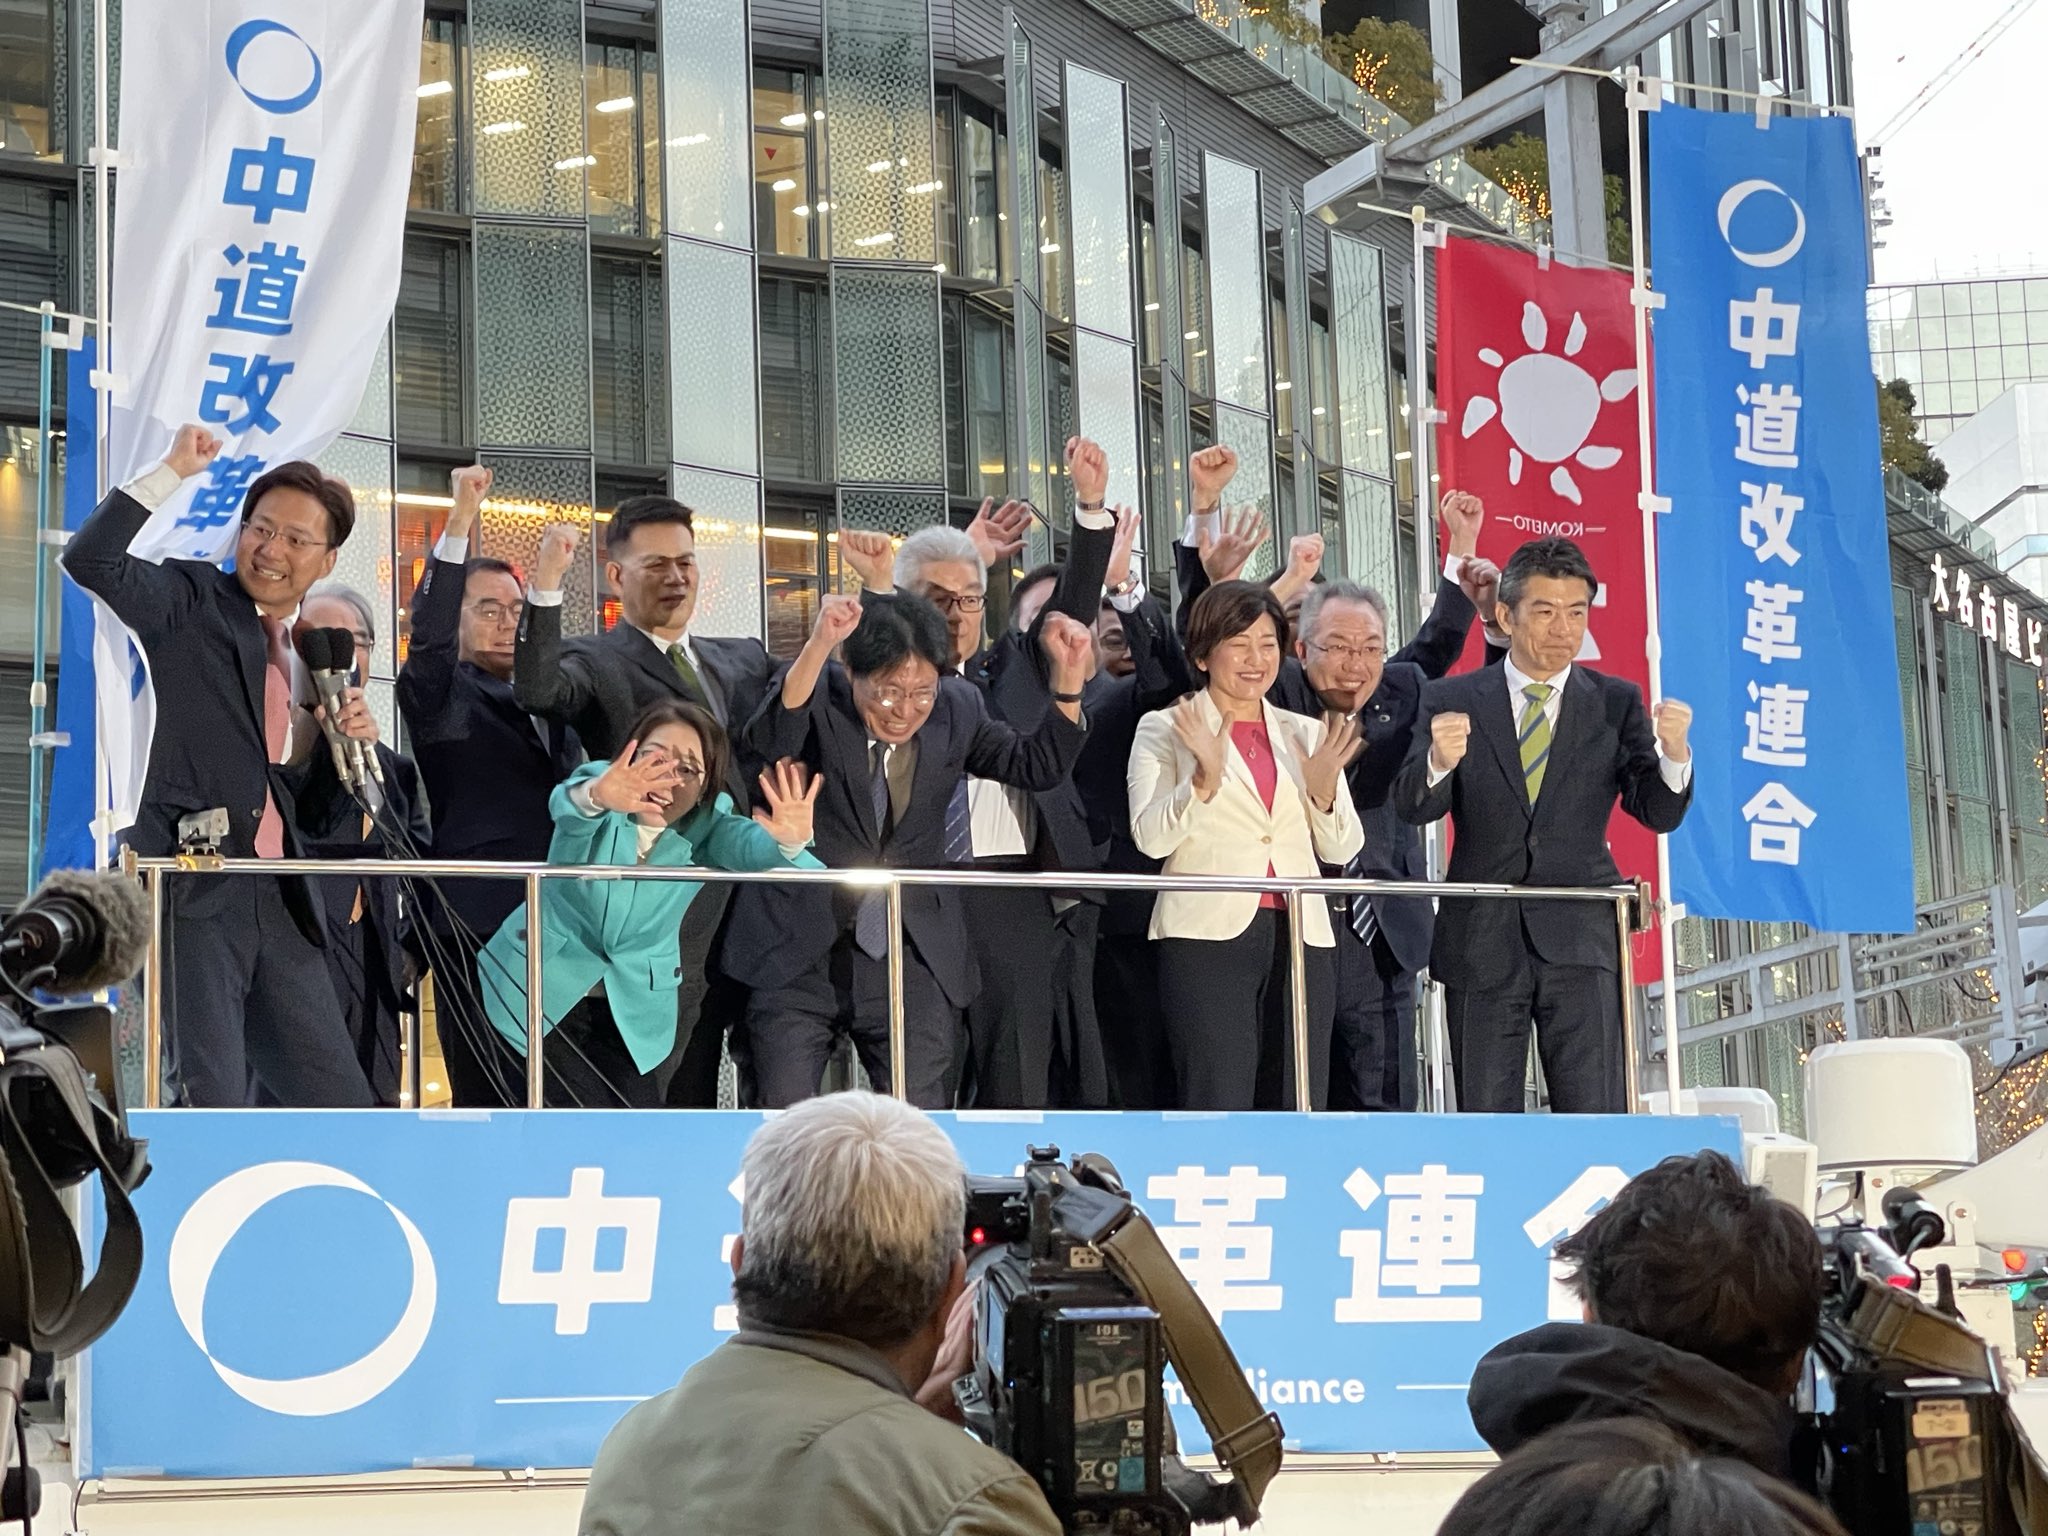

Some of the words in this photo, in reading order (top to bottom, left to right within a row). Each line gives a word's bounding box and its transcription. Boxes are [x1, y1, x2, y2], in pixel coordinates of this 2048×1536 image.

[174, 138, 314, 557] 中道改革
[1729, 287, 1817, 865] 中道改革連合
[1930, 553, 2042, 667] 大名古屋ビ
[497, 1164, 1632, 1336] 中革連
[1074, 1369, 1145, 1424] 150
[1245, 1368, 1366, 1404] liance
